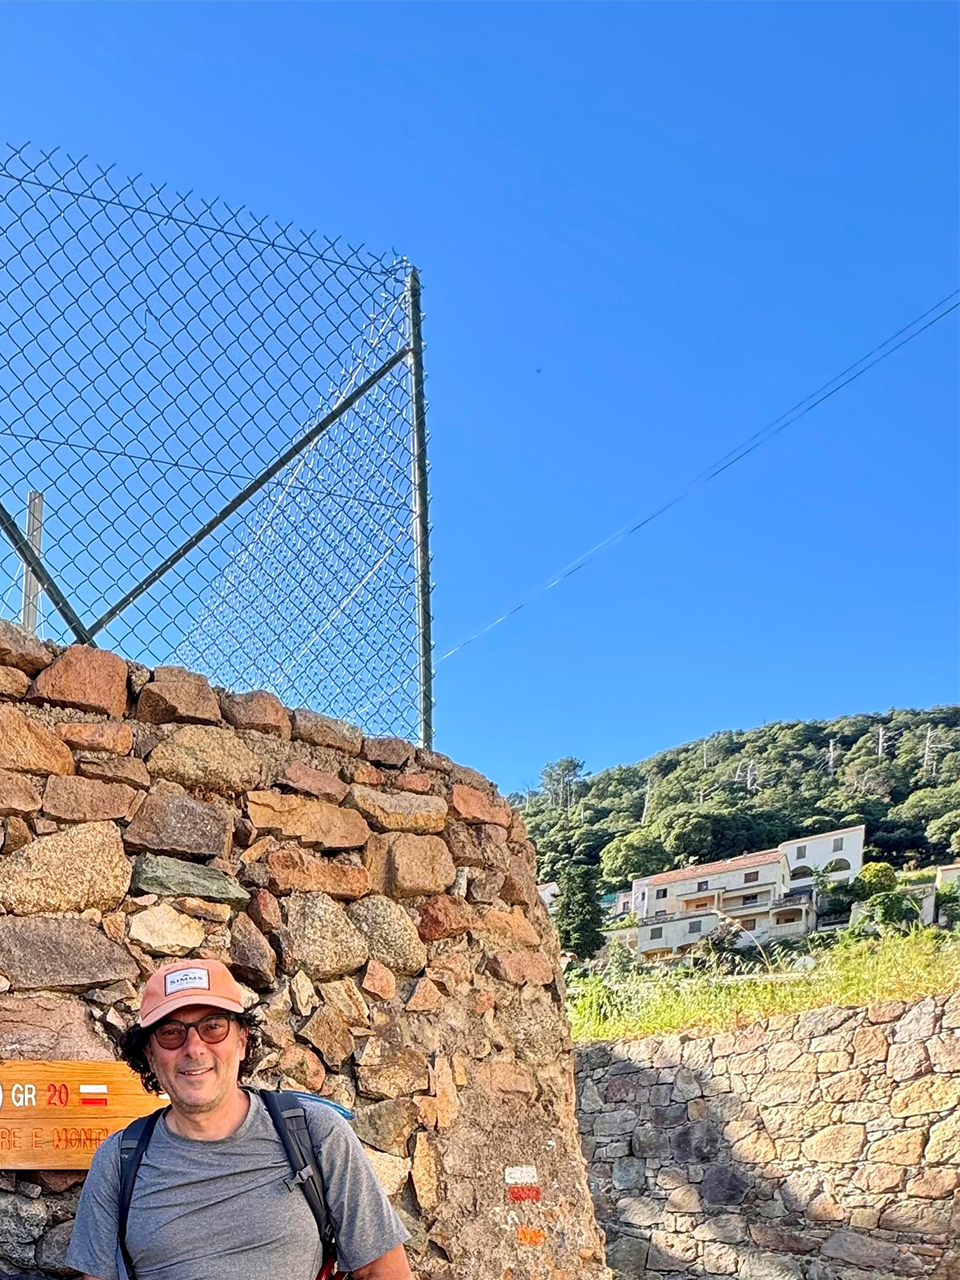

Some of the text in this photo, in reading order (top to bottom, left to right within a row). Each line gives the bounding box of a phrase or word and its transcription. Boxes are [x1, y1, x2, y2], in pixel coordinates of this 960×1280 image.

[11, 1083, 69, 1107] GR 20
[32, 1127, 44, 1150] E
